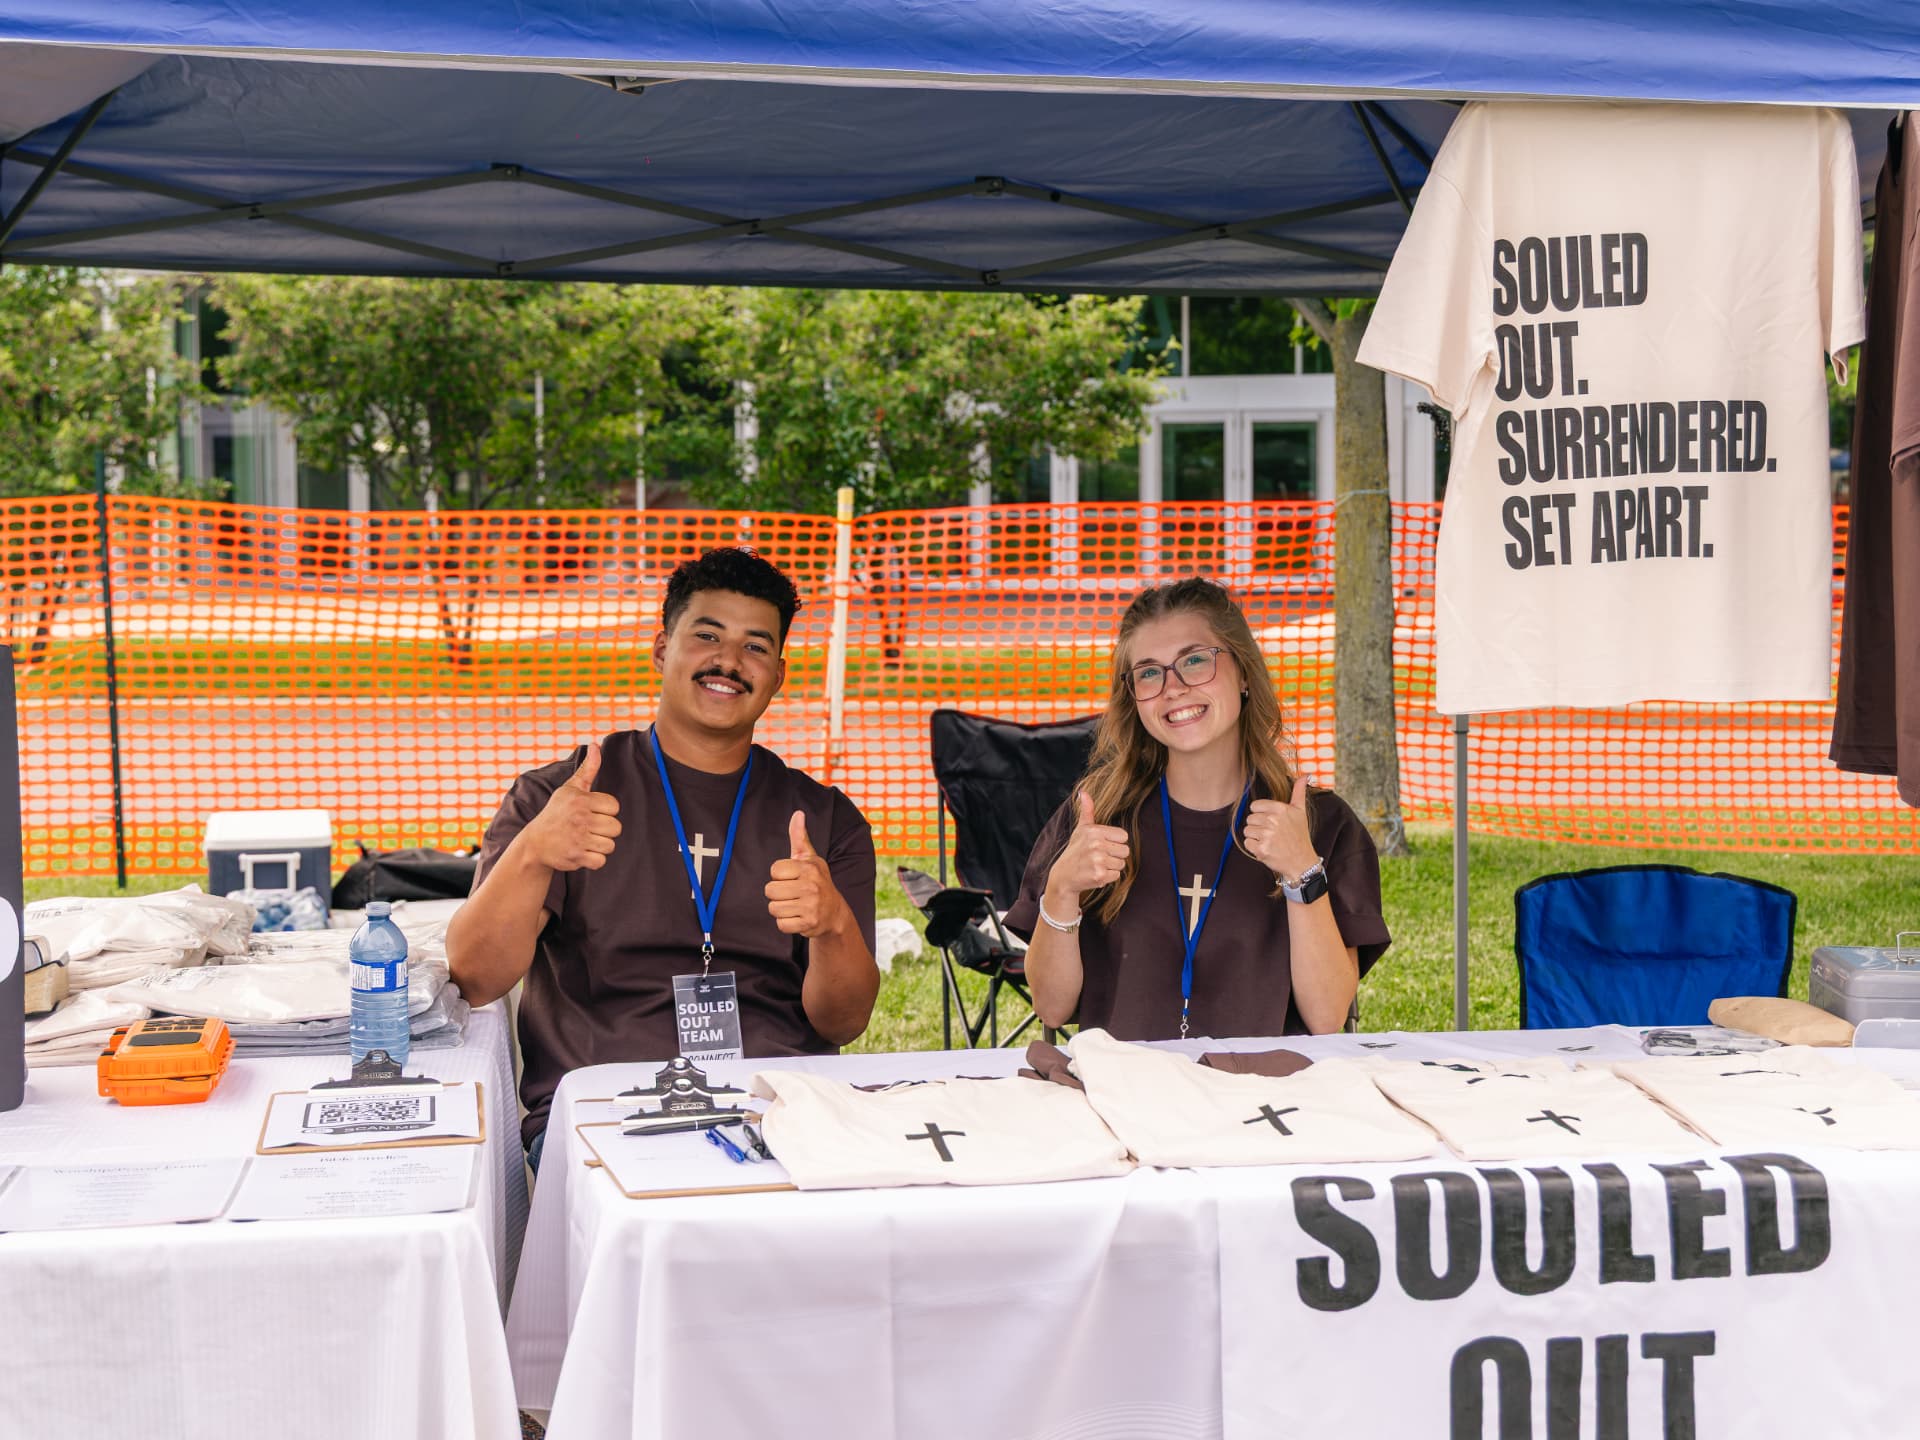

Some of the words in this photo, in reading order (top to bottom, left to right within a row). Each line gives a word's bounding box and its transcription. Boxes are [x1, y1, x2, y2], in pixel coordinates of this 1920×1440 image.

[1493, 233, 1648, 317] SOULED
[1495, 321, 1588, 402] OUT.
[1497, 400, 1777, 486] SURRENDERED.
[1502, 490, 1576, 570] SET
[1591, 485, 1714, 564] APART.
[679, 1000, 735, 1015] SOULED
[679, 1016, 711, 1030] OUT
[680, 1029, 724, 1044] TEAM
[344, 1125, 390, 1134] SCAN
[1291, 1152, 1831, 1312] SOULED
[1449, 1330, 1716, 1440] OUT
